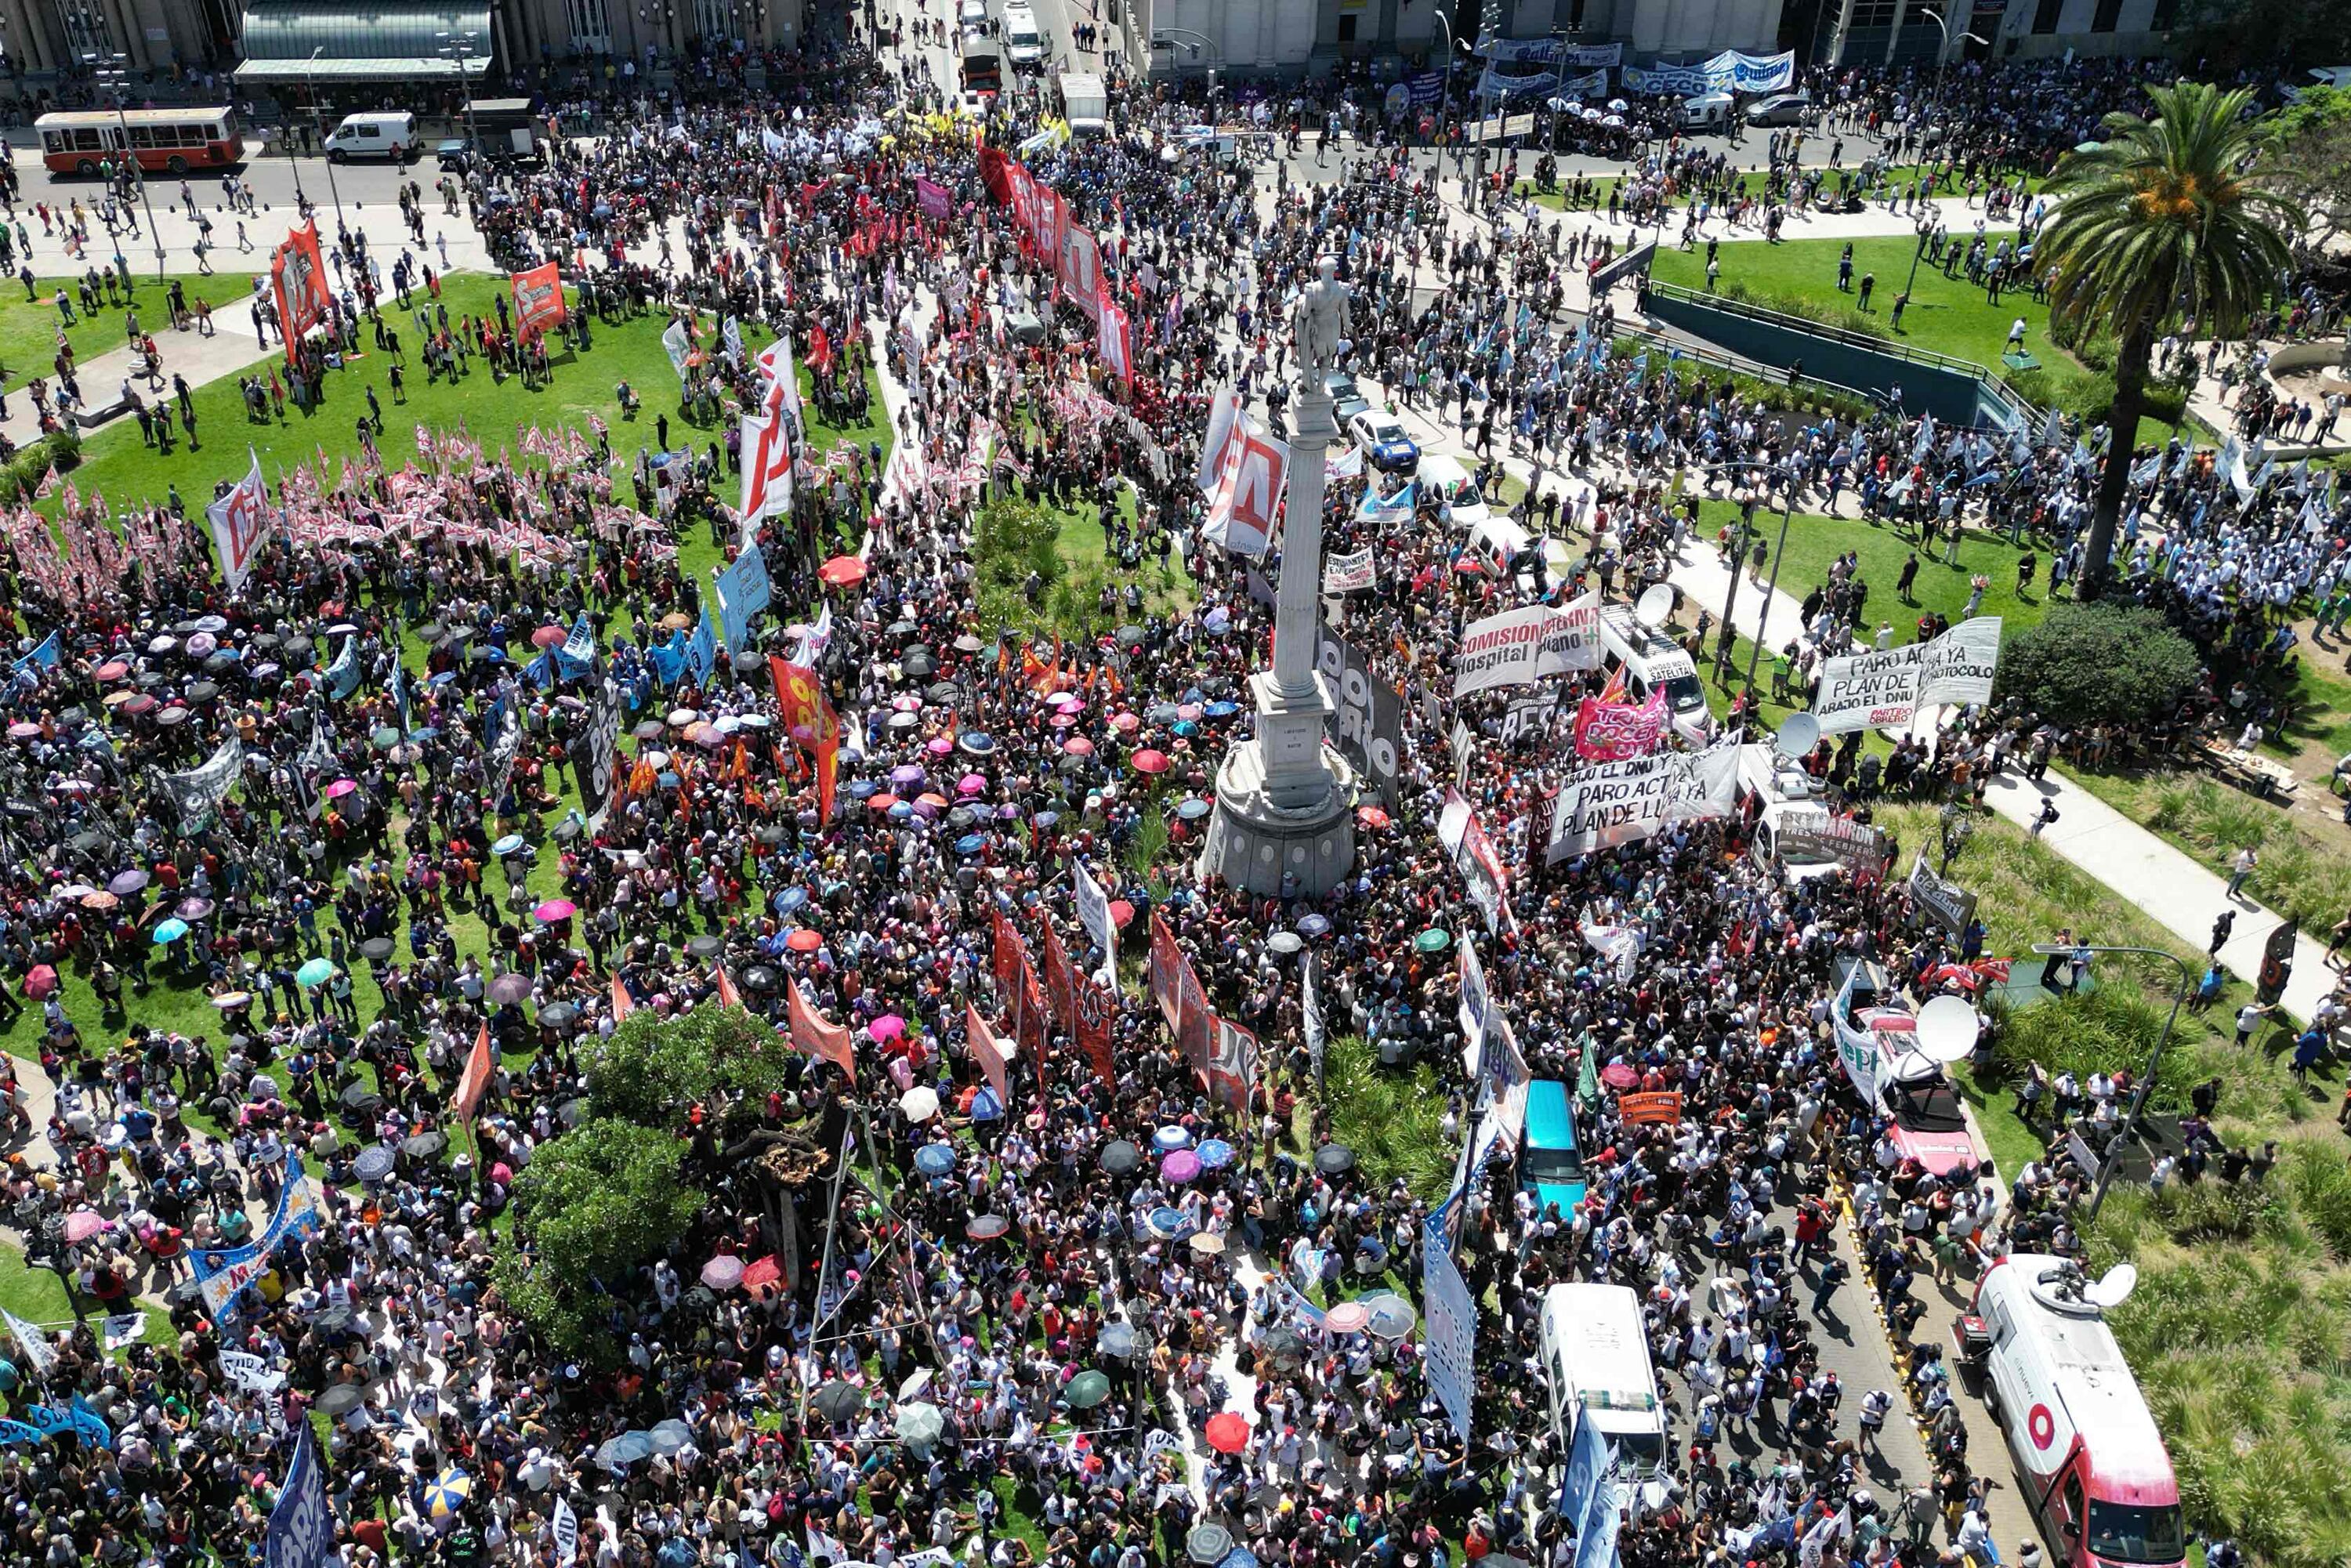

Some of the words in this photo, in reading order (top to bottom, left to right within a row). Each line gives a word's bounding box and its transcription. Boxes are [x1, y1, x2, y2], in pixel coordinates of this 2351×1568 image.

[1456, 644, 1527, 677] Hospital
[1834, 678, 1881, 697] PLAN
[1886, 672, 1913, 690] DE
[1947, 646, 1965, 663] YA
[1850, 654, 1900, 676] PARO
[1650, 666, 1693, 681] SATELITAL
[1818, 697, 1860, 716] ABAJO
[1864, 695, 1878, 706] EL
[1886, 690, 1913, 704] DNU
[1871, 708, 1913, 716] PARTIDO
[1869, 715, 1908, 724] OBRERO
[1564, 766, 1596, 791] ABAJO
[1601, 763, 1619, 778] EL
[1625, 761, 1654, 776] DNU
[1578, 784, 1628, 808] PARO
[1563, 807, 1607, 839] PLAN
[1613, 802, 1638, 824] DE
[1686, 780, 1707, 801] YA
[1786, 828, 1811, 838] TRES
[1828, 838, 1876, 857] FEBRERO
[1916, 874, 1935, 892] de
